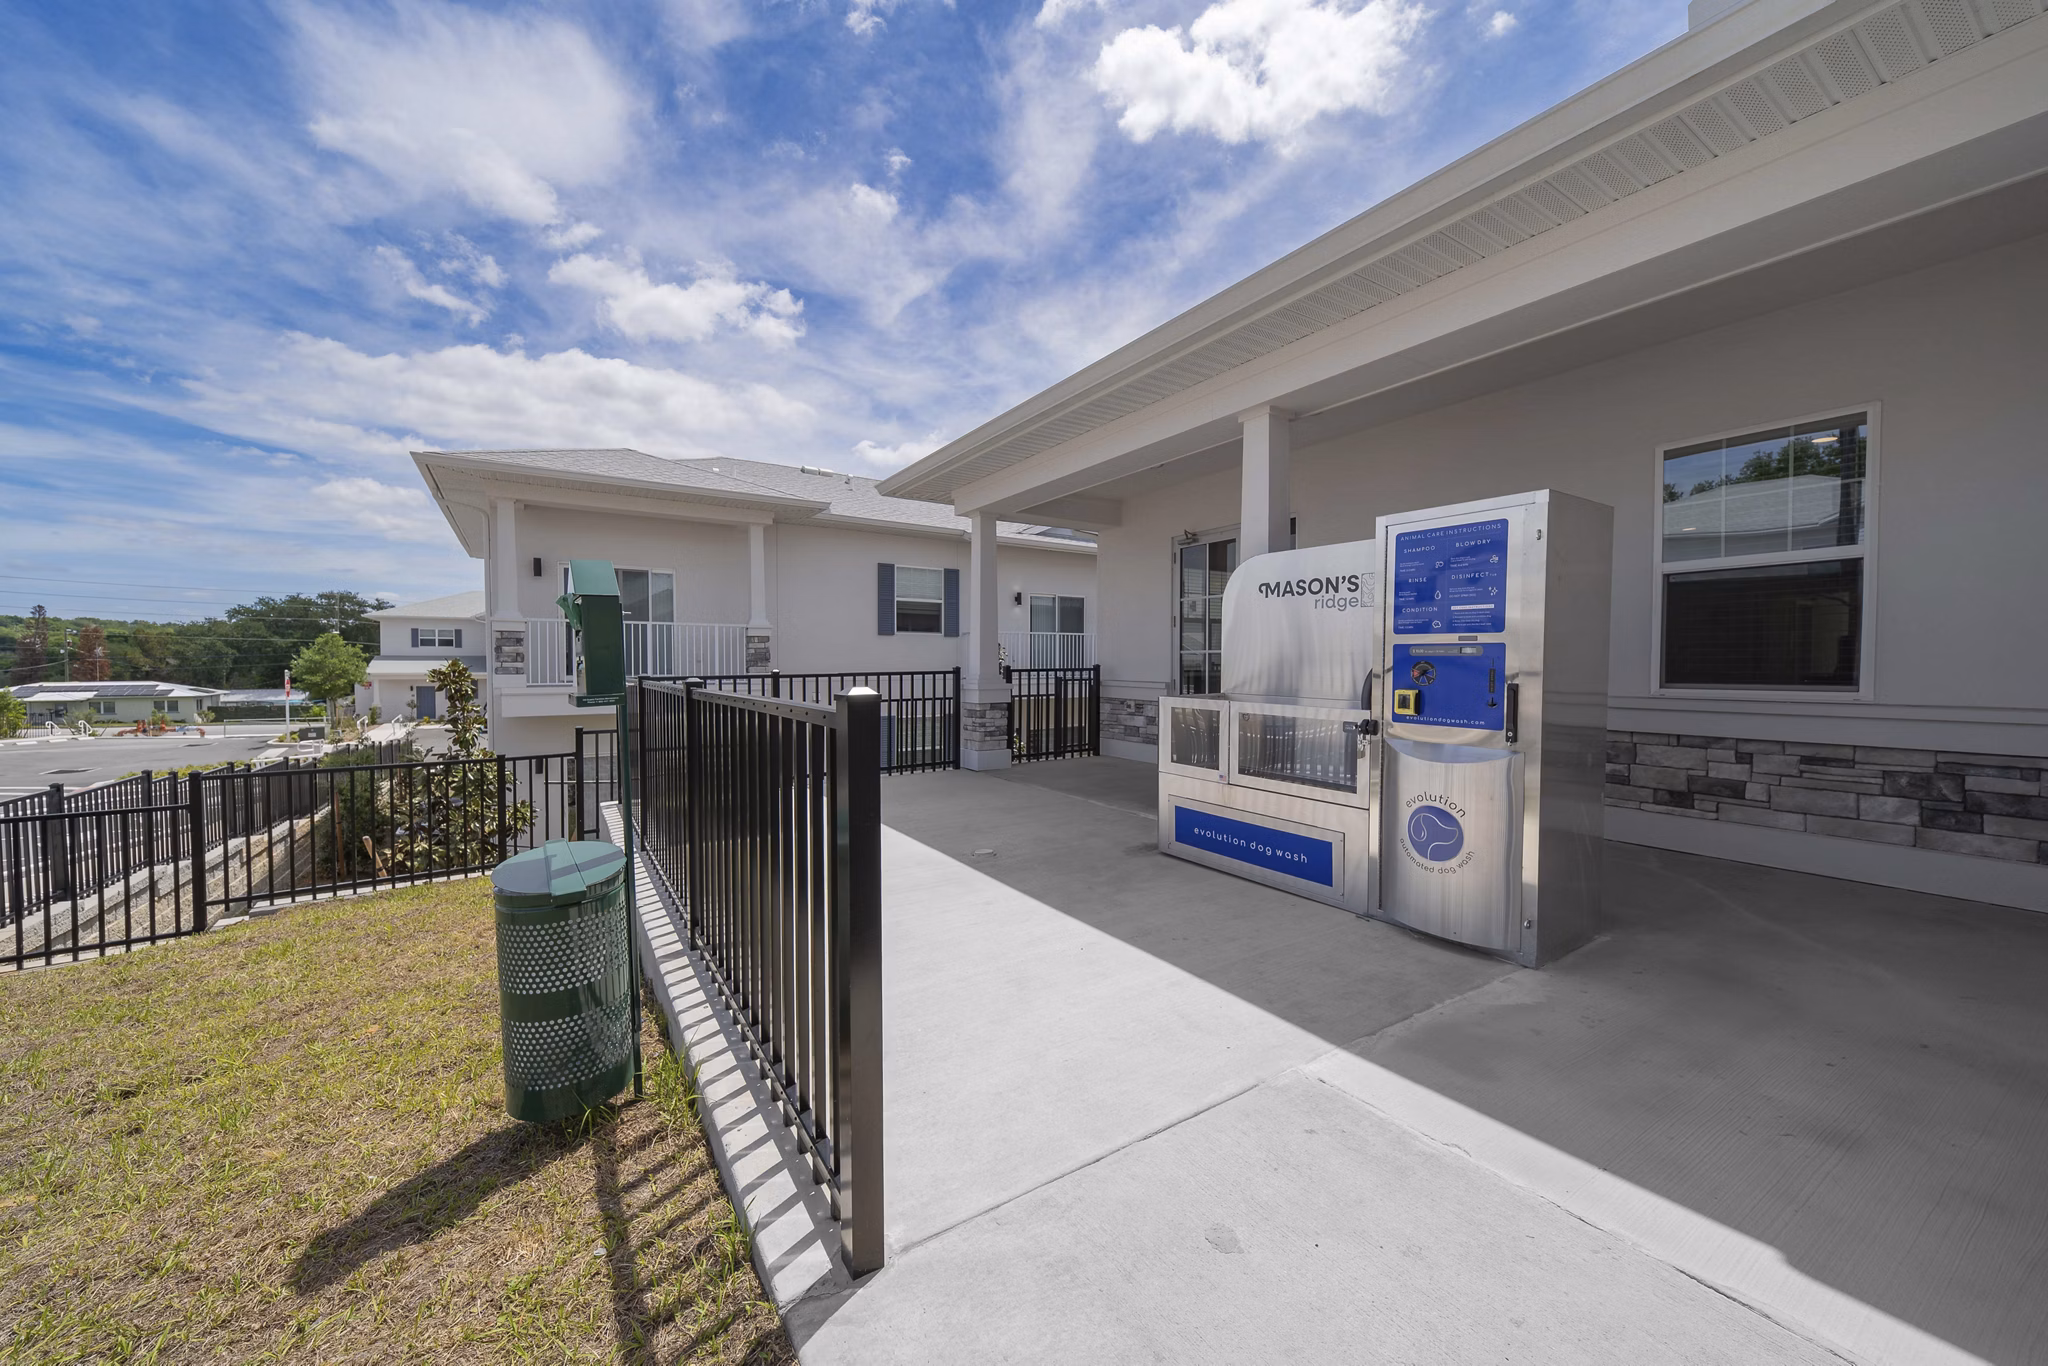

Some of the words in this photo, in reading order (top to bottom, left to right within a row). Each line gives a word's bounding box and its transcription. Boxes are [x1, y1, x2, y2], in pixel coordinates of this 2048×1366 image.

[1426, 530, 1445, 538] CARE
[1446, 523, 1502, 535] INSTRUCTIONS
[1403, 545, 1436, 554] SHAMPOO
[1455, 540, 1476, 548] BLOW
[1451, 571, 1490, 580] DISINFECT
[1258, 574, 1360, 599] MASON'S
[1314, 594, 1359, 612] ridge
[1406, 715, 1485, 725] evolutiondogwash.com
[1405, 791, 1466, 818] evolution
[1194, 827, 1247, 847] evolution
[1249, 841, 1272, 856] dog
[1275, 848, 1308, 863] wash
[1399, 838, 1435, 873] automated
[1437, 866, 1457, 874] dog
[1456, 850, 1476, 869] wash
